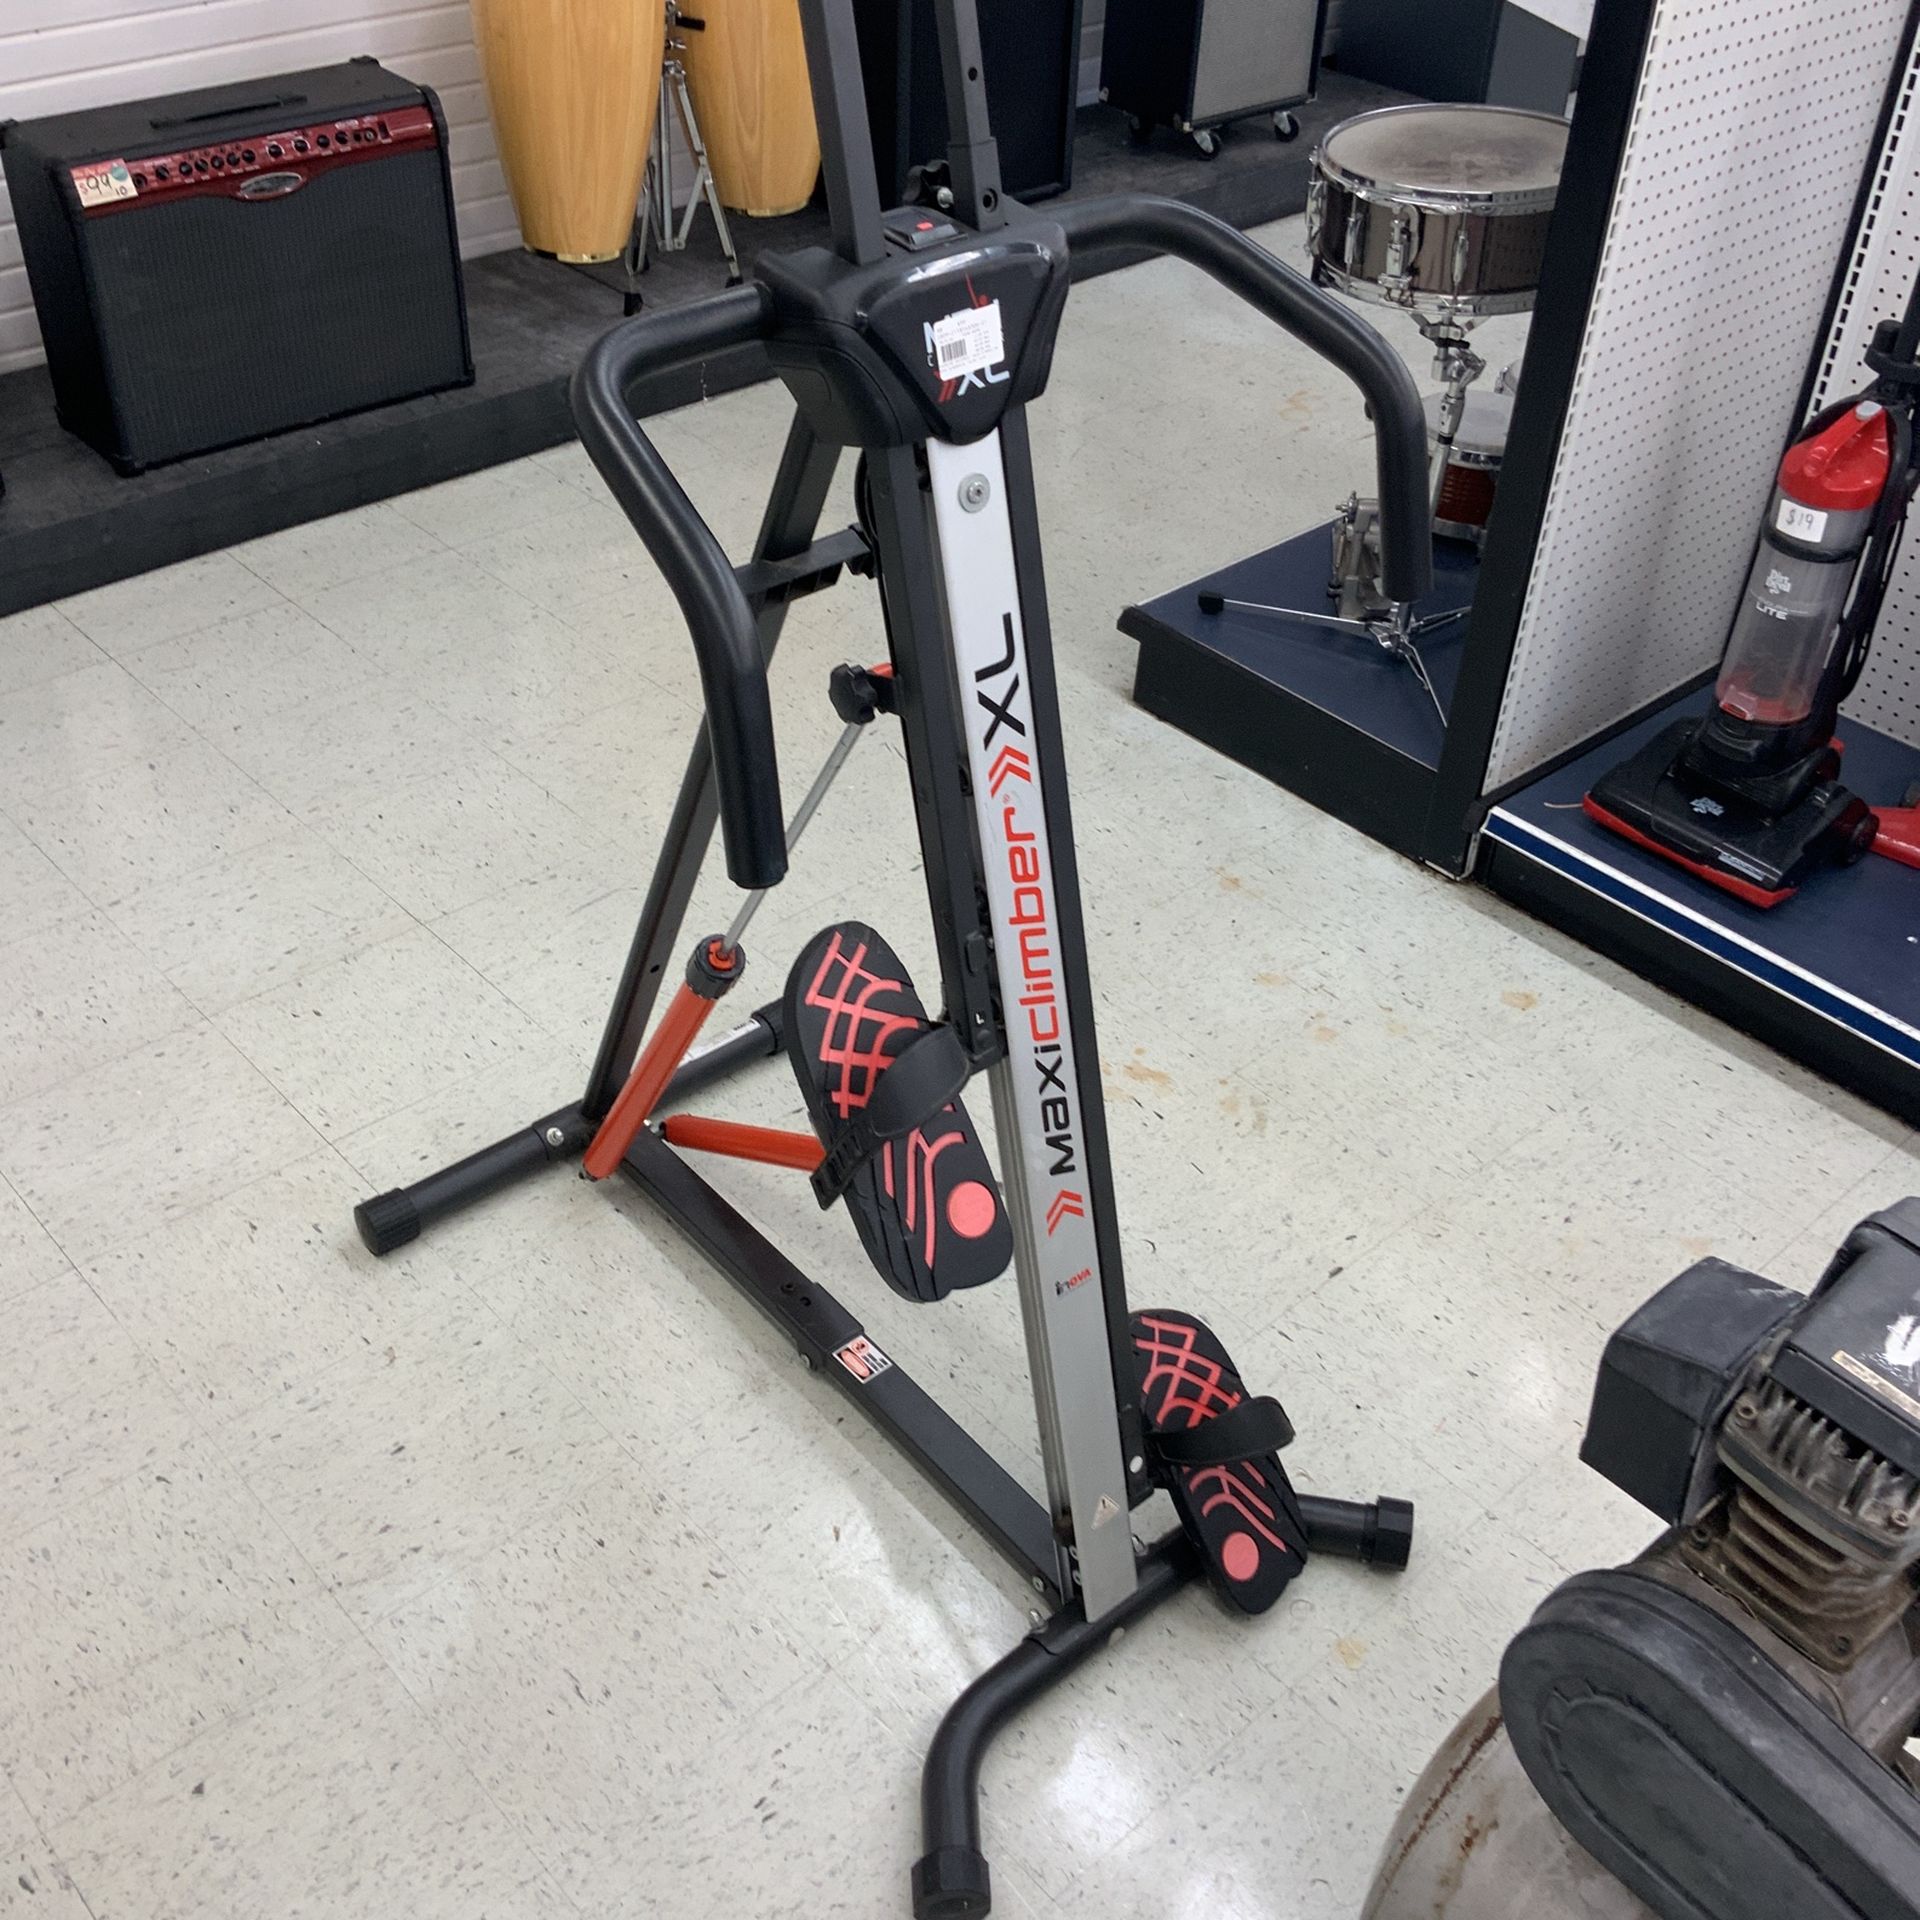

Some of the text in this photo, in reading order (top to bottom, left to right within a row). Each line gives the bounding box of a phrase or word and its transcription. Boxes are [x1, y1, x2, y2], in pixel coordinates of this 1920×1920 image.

[1785, 507, 1815, 531] $19
[1756, 601, 1788, 620] LITE
[973, 612, 1027, 752] XL
